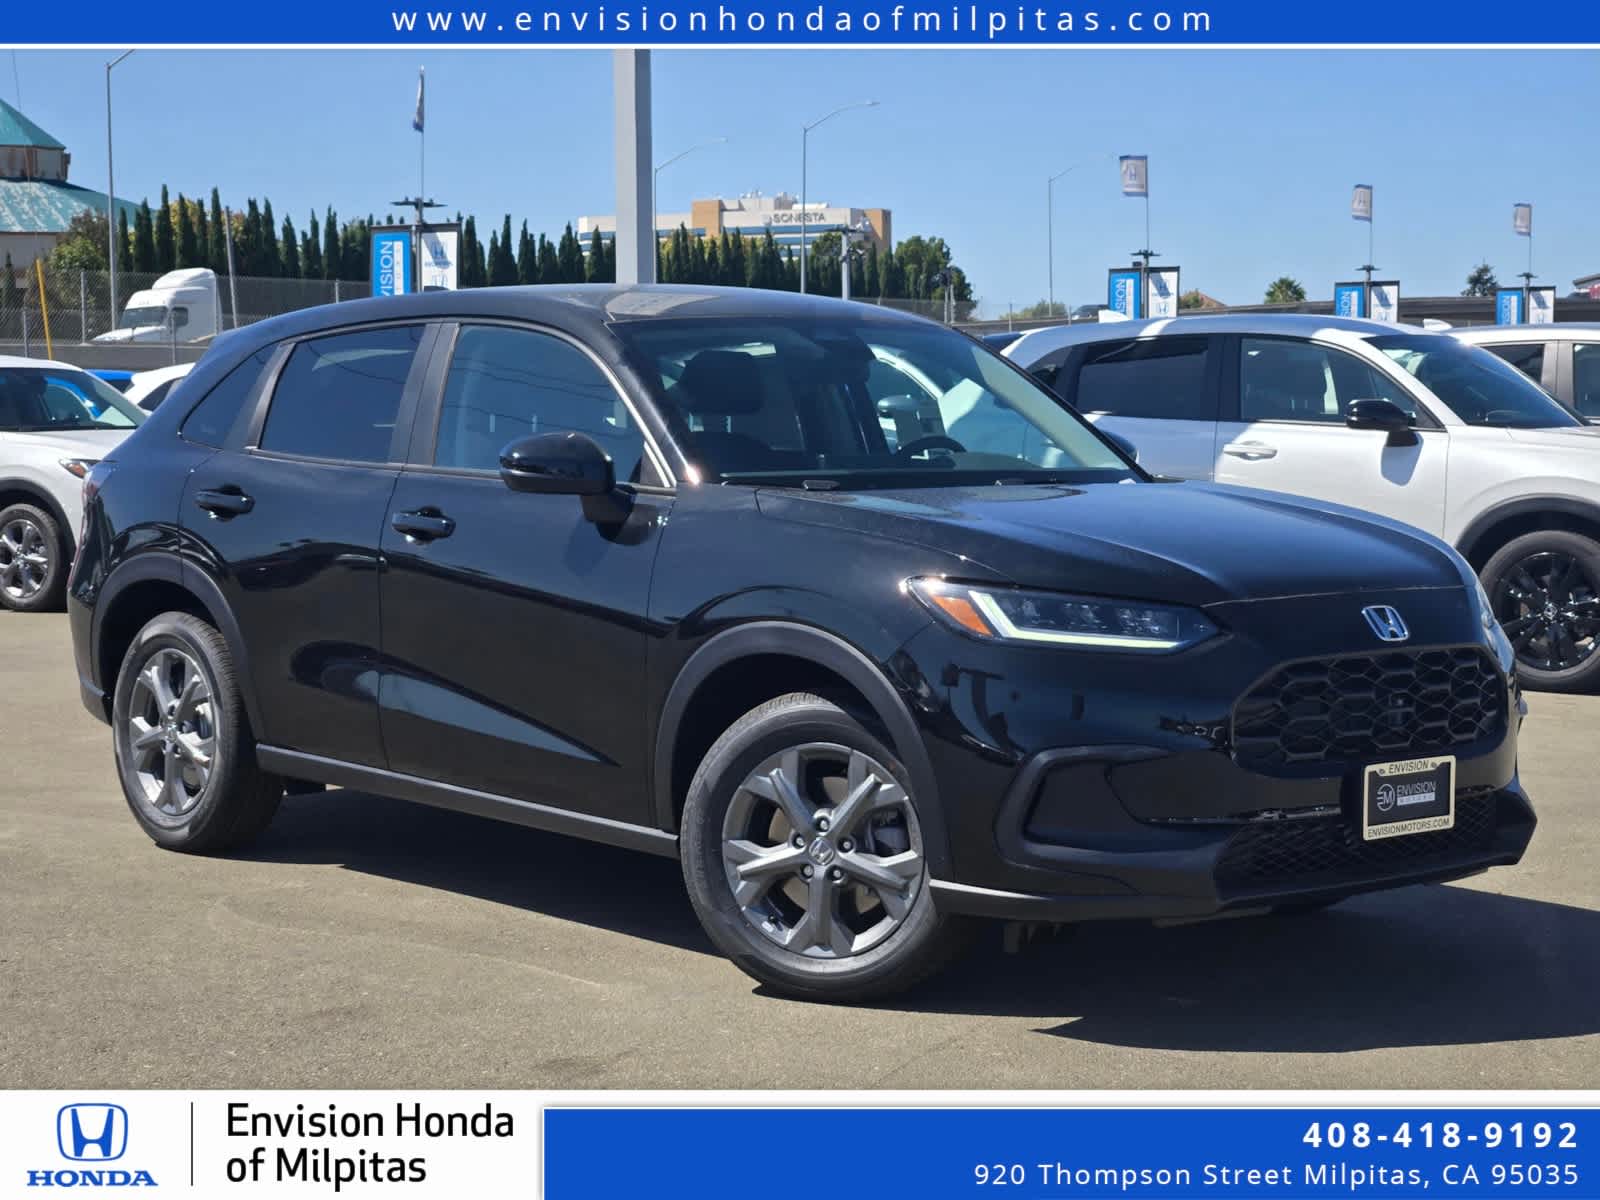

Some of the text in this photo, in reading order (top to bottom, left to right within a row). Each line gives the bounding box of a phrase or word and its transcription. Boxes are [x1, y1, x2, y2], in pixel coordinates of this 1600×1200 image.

[773, 211, 827, 224] SONESTA
[1388, 760, 1429, 775] ENVISION
[1396, 781, 1437, 797] ENVISION
[1367, 818, 1450, 838] ENVISIONMOTORS.COM
